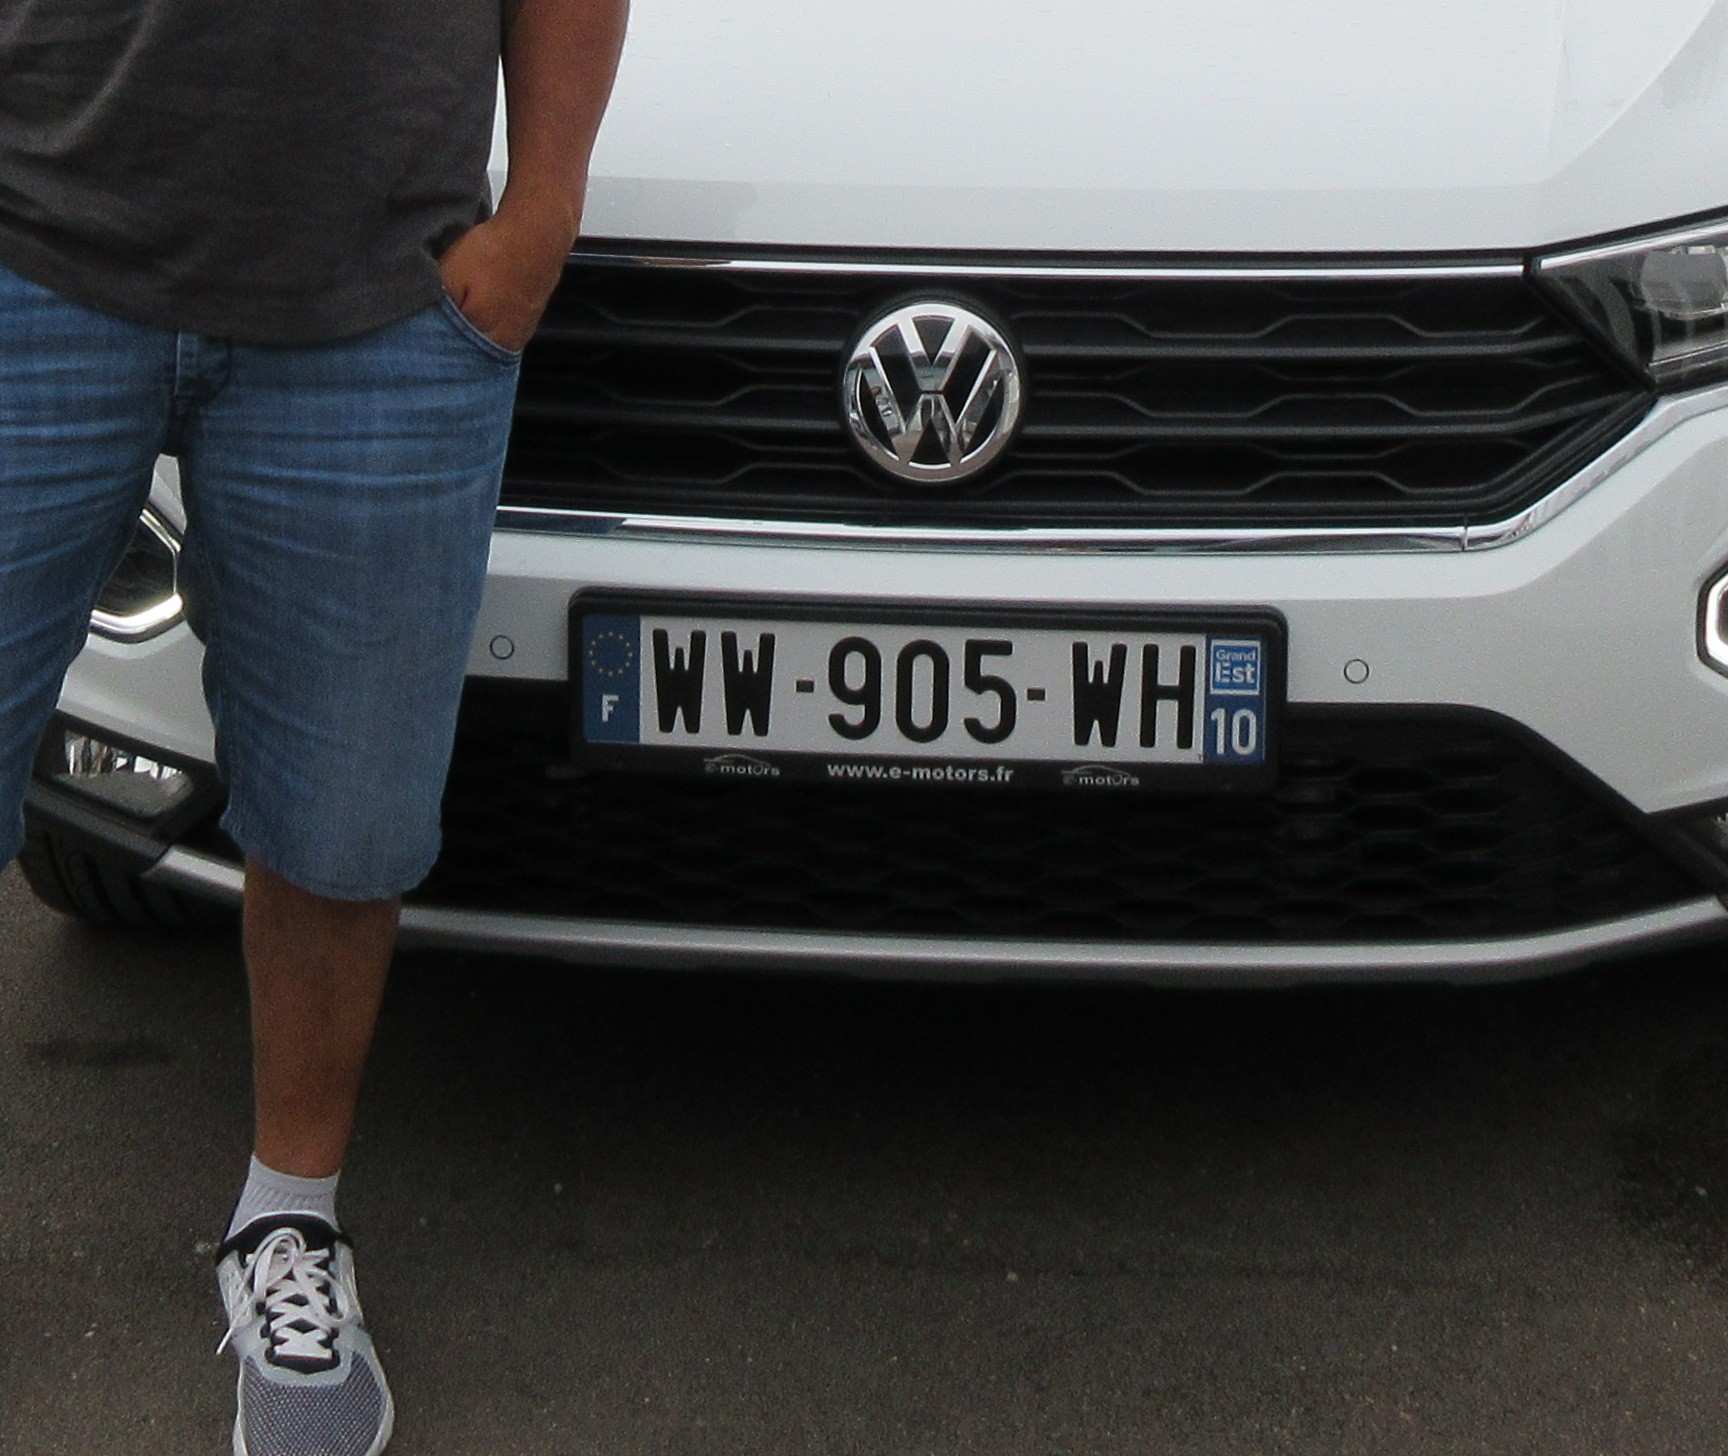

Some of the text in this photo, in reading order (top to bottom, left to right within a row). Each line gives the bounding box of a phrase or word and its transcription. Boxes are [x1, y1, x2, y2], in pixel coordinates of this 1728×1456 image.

[1215, 649, 1256, 661] Grand
[1215, 661, 1256, 684] Est
[652, 628, 1196, 750] WW-905-WH
[601, 694, 620, 722] F
[1210, 707, 1257, 756] 10
[827, 761, 1014, 784] www.e-motors.fr
